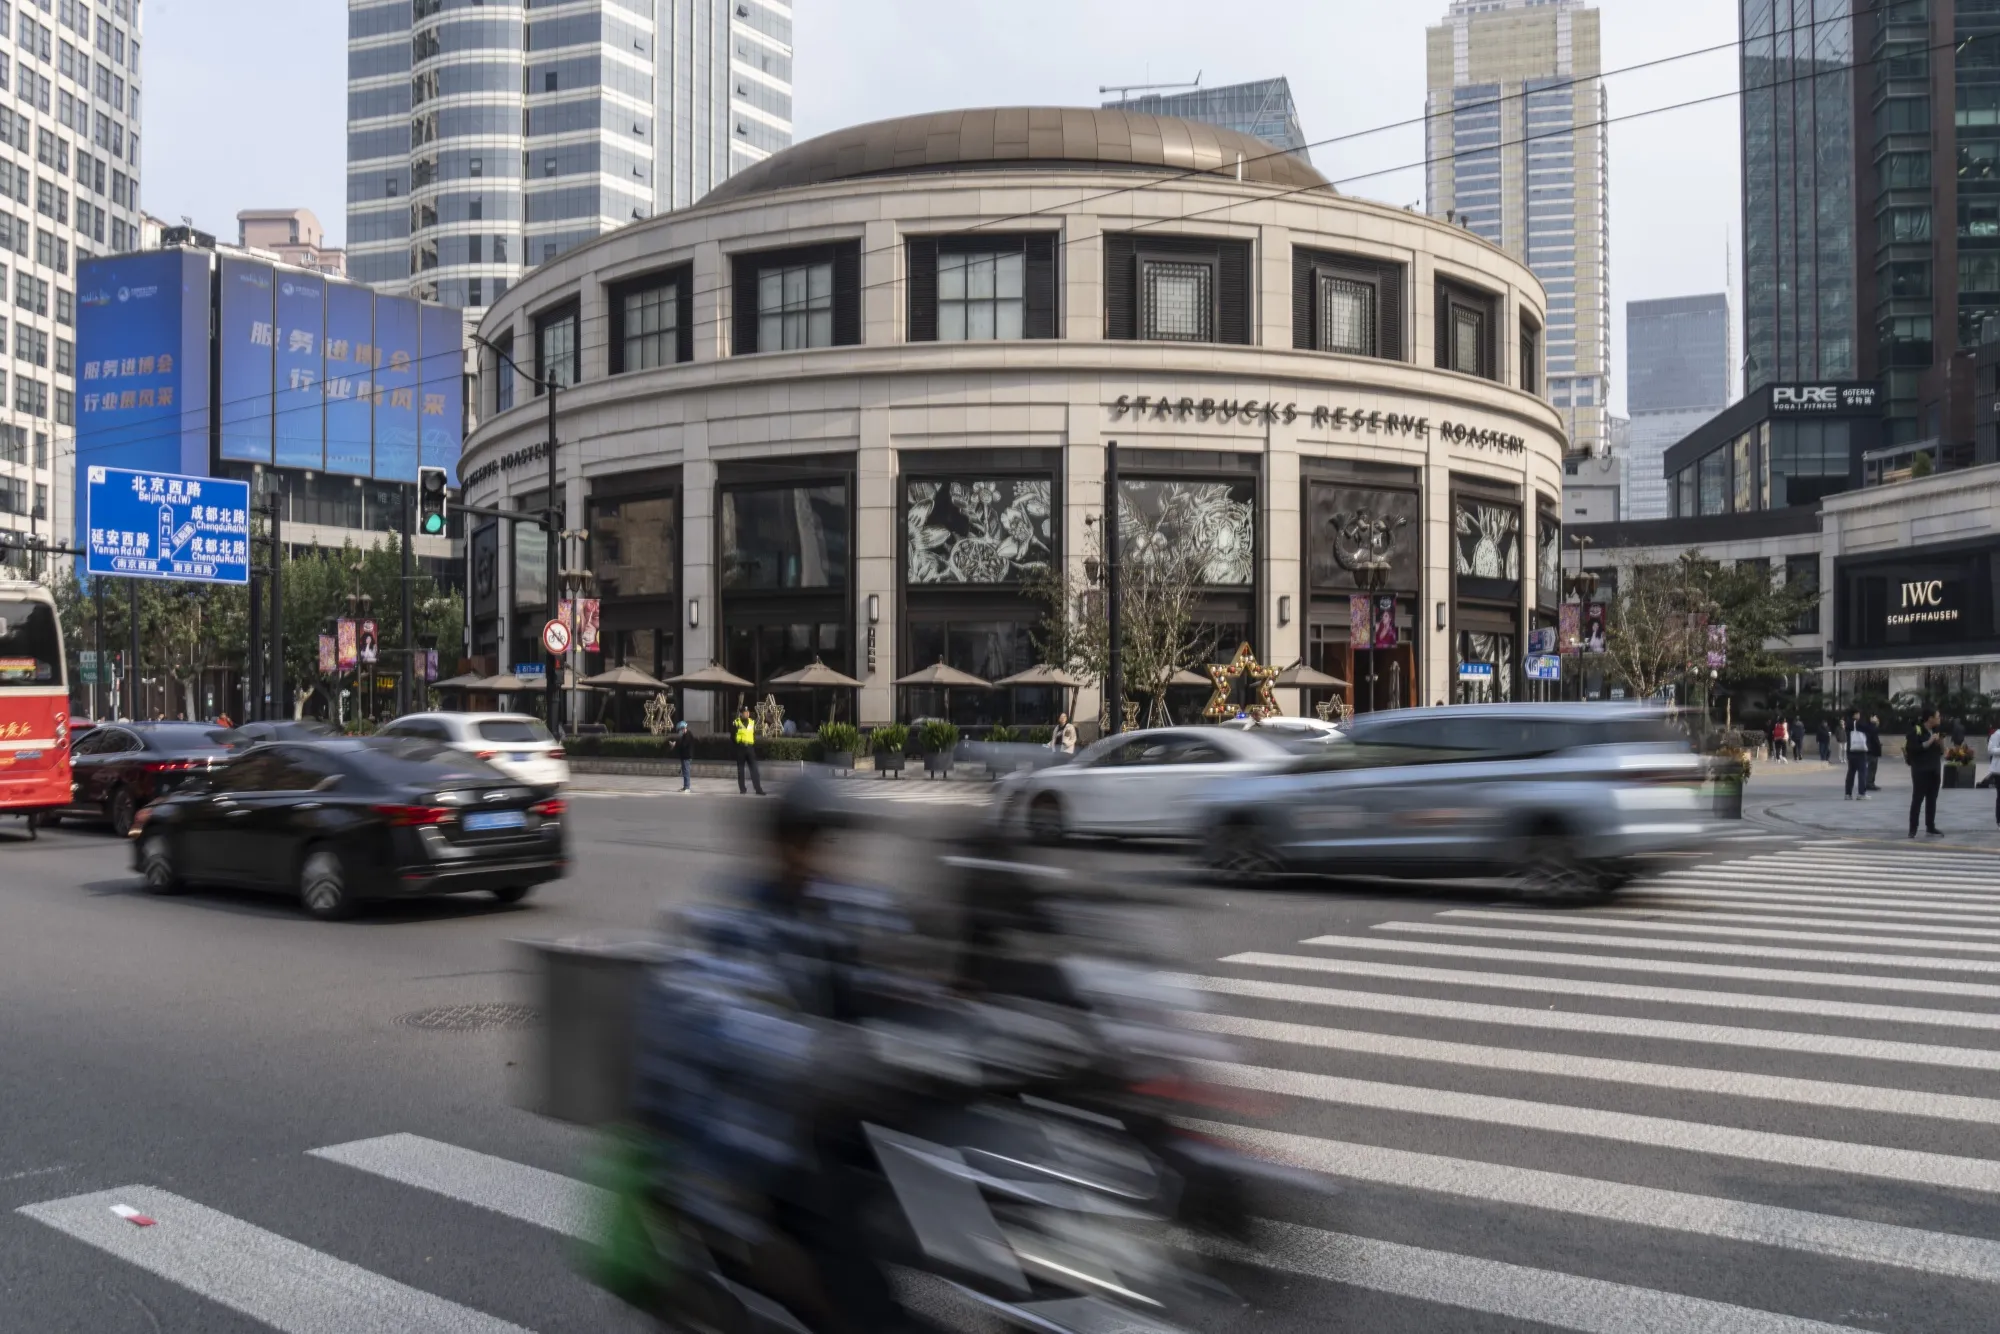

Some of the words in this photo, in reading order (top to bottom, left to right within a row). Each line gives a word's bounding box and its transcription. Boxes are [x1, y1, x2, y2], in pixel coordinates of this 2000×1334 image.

[1773, 386, 1837, 403] PURE
[1117, 394, 1298, 421] STARBUCKS
[1315, 405, 1430, 435] RESERVE
[1442, 420, 1526, 453] ROASTERY
[132, 476, 201, 497] 北京西路
[139, 491, 166, 504] Beijing
[191, 505, 245, 524] 成都北路
[91, 528, 149, 548] 延安西路
[161, 512, 171, 559] 石门二路
[191, 536, 245, 555] 成都北路
[117, 558, 158, 571] 南京西路
[173, 562, 213, 575] 南京西路
[1901, 580, 1942, 608] IWC
[1887, 610, 1958, 625] SCHAFFHAUSEN
